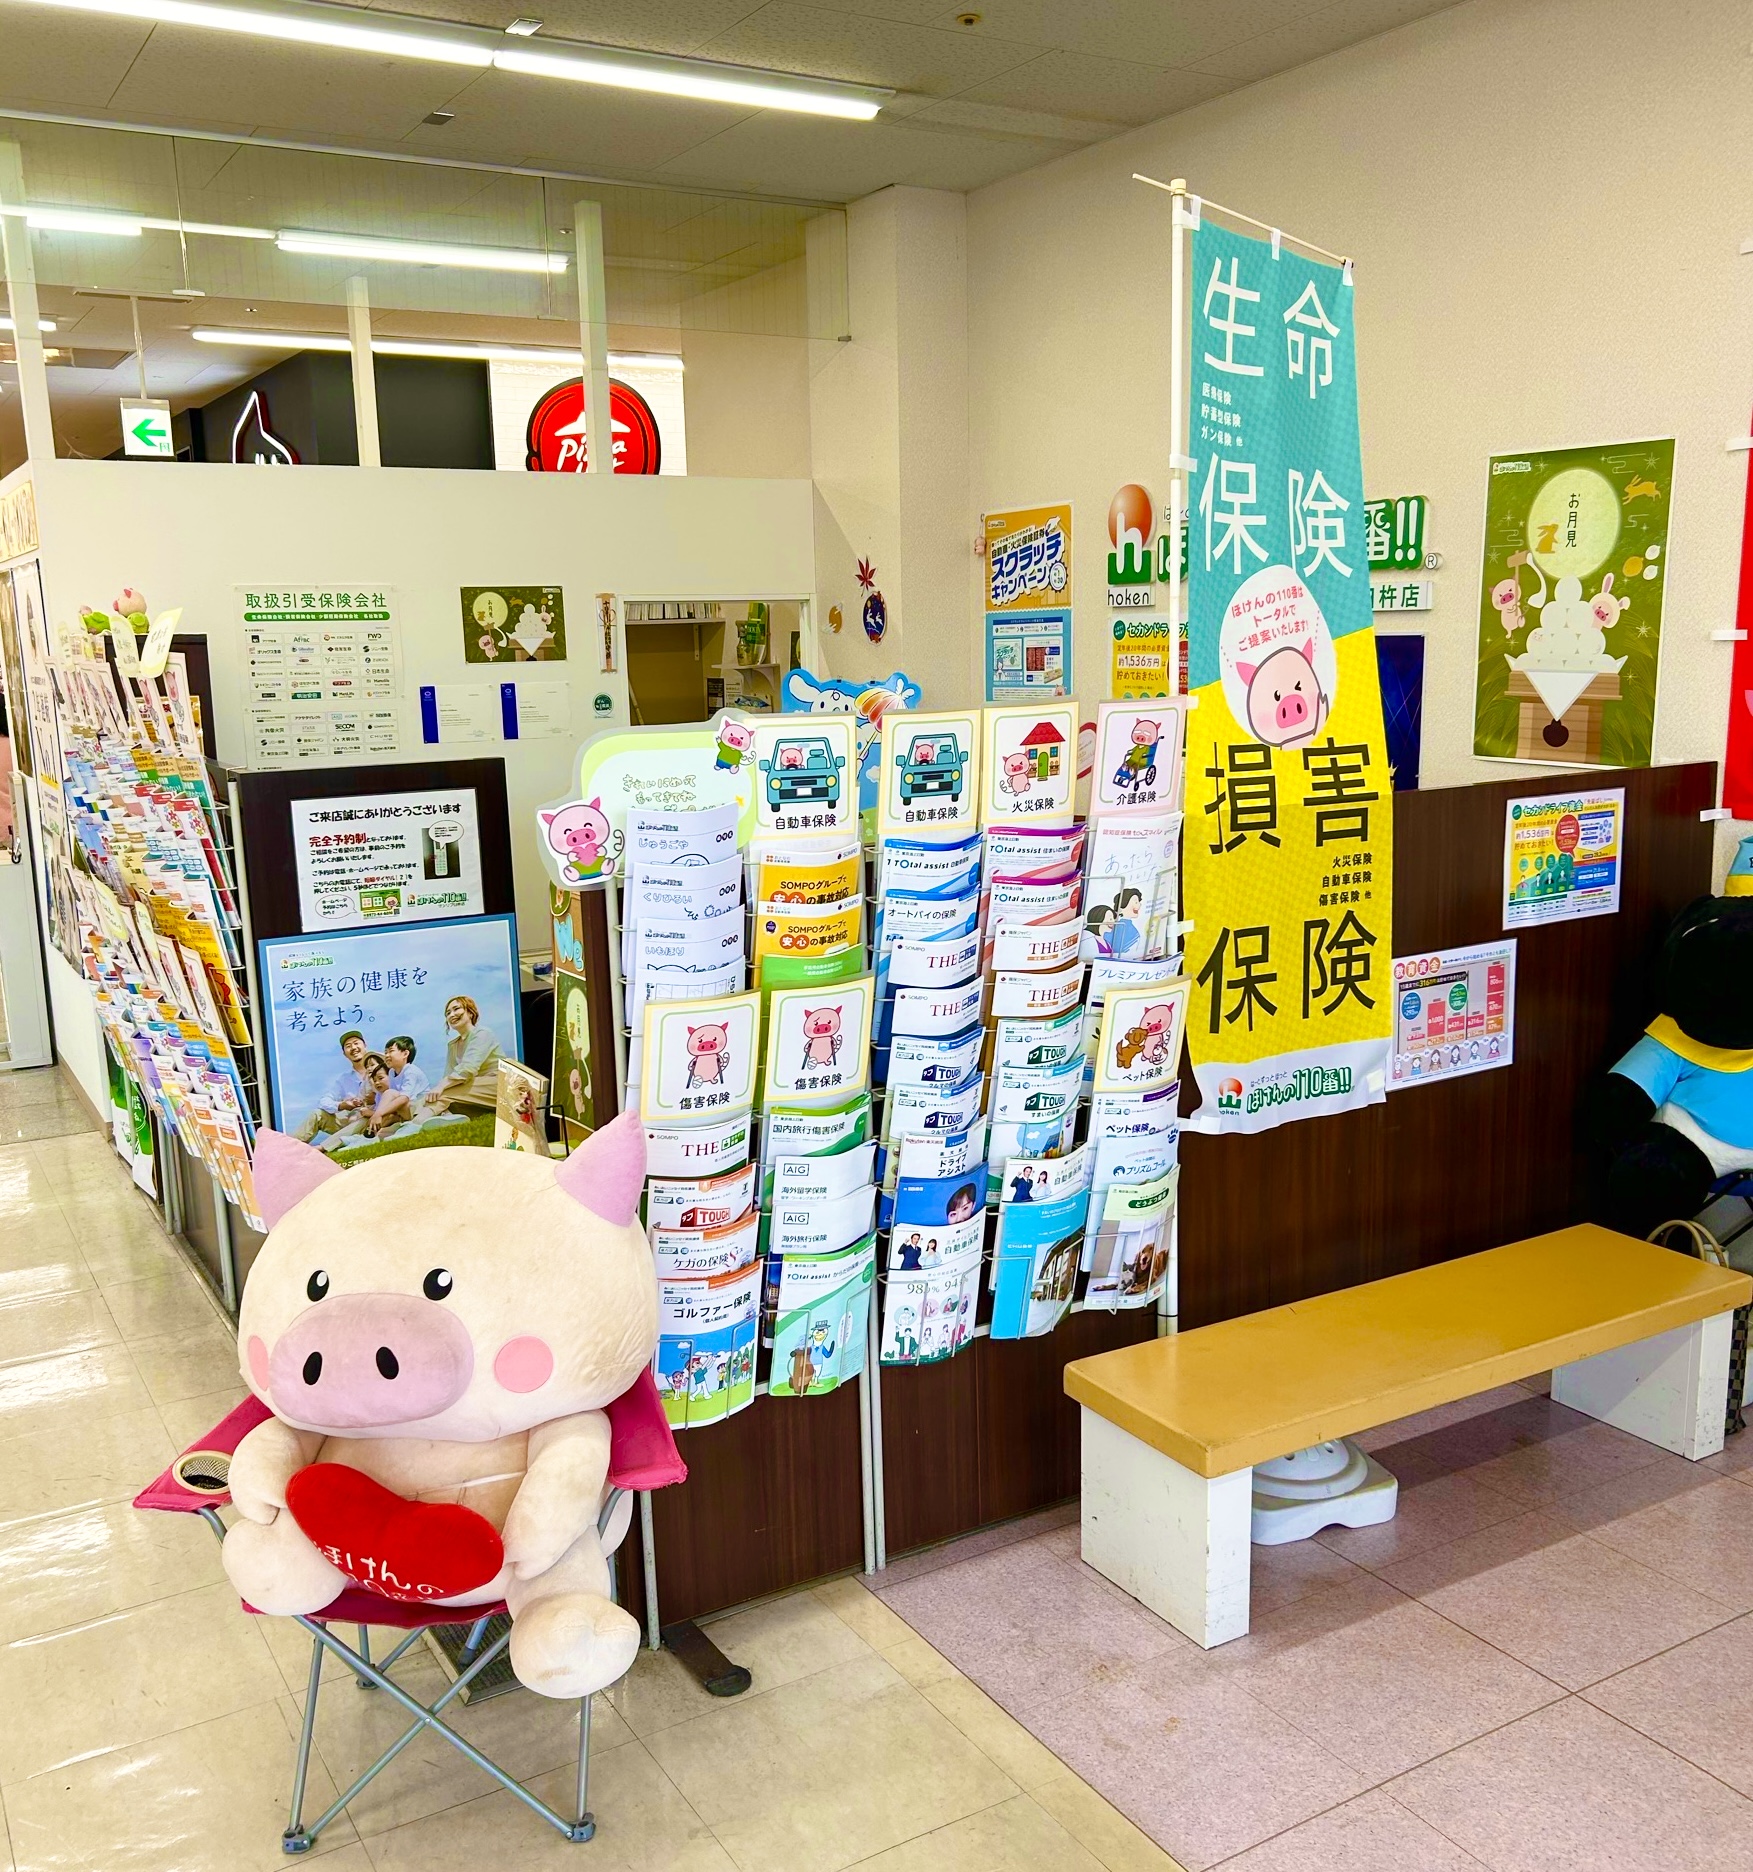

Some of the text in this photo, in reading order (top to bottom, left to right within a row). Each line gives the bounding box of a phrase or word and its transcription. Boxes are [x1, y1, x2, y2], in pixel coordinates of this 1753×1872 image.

[1203, 256, 1341, 400] 生命
[1202, 425, 1232, 447] ガン保険
[1199, 452, 1353, 579] 保険
[1566, 492, 1580, 548] お月見
[992, 533, 1061, 582] スクラッチ
[992, 566, 1047, 599] キャンペーン
[245, 593, 387, 608] 取扱引受保険会社
[1107, 589, 1149, 606] hoken
[1231, 586, 1304, 618] ほけんの110番は
[1370, 584, 1419, 609] 杵店
[1253, 604, 1296, 628] トータルで
[636, 790, 696, 804] もってきてね
[1116, 791, 1156, 806] 介護保険
[1204, 737, 1379, 855] 損害
[309, 803, 462, 822] ご来店誠にありがとうございます
[1012, 798, 1054, 813] 火災保険
[1524, 799, 1584, 818] セカンドライフ資金
[776, 814, 837, 830] 自動車保険
[906, 807, 958, 822] 自動車保険
[638, 838, 689, 850] じゅうごや
[1016, 846, 1041, 854] assist
[924, 860, 949, 869] assist
[1332, 852, 1372, 868] 火災保険
[780, 875, 847, 890] SOMPOグループで
[1322, 871, 1372, 888] 自動車保険
[643, 892, 692, 904] くりひろい
[773, 887, 850, 904] 安心の事故対応
[1319, 890, 1372, 907] 傷害保険 他
[888, 908, 956, 920] オートバイの保険
[788, 920, 847, 934] SOMPOグループで
[782, 930, 849, 946] 安心の事故対応
[1029, 940, 1060, 954] THE
[927, 954, 958, 968] THE
[1394, 958, 1441, 979] 教育資金
[1196, 910, 1378, 1035] 保険
[282, 966, 428, 1002] 家族の健康を
[1029, 989, 1060, 1002] THE
[930, 1002, 961, 1016] THE
[286, 1004, 375, 1032] 考えよう。
[1044, 1047, 1066, 1060] TOUGH
[938, 1068, 962, 1080] TOUGH
[1122, 1066, 1163, 1082] ペット保険
[794, 1074, 842, 1090] 傷害保険
[679, 1092, 731, 1110] 傷害保険
[1043, 1094, 1066, 1106] TOUGH
[941, 1114, 963, 1126] TOUGH
[773, 1121, 845, 1135] 国内旅行傷害保険
[1106, 1122, 1150, 1134] ペット保険
[681, 1142, 720, 1156] THE
[940, 1153, 967, 1168] ドライブ
[786, 1166, 806, 1174] AIG
[938, 1163, 966, 1177] アシスト
[1126, 1161, 1167, 1176] プリズムコール
[781, 1186, 828, 1194] 海外留学保険
[700, 1208, 731, 1223] TOUGH
[786, 1214, 806, 1222] AIG
[782, 1234, 828, 1243] 海外旅行保険
[944, 1234, 980, 1255] 自動車保険
[674, 1291, 752, 1319] ゴルファー保険
